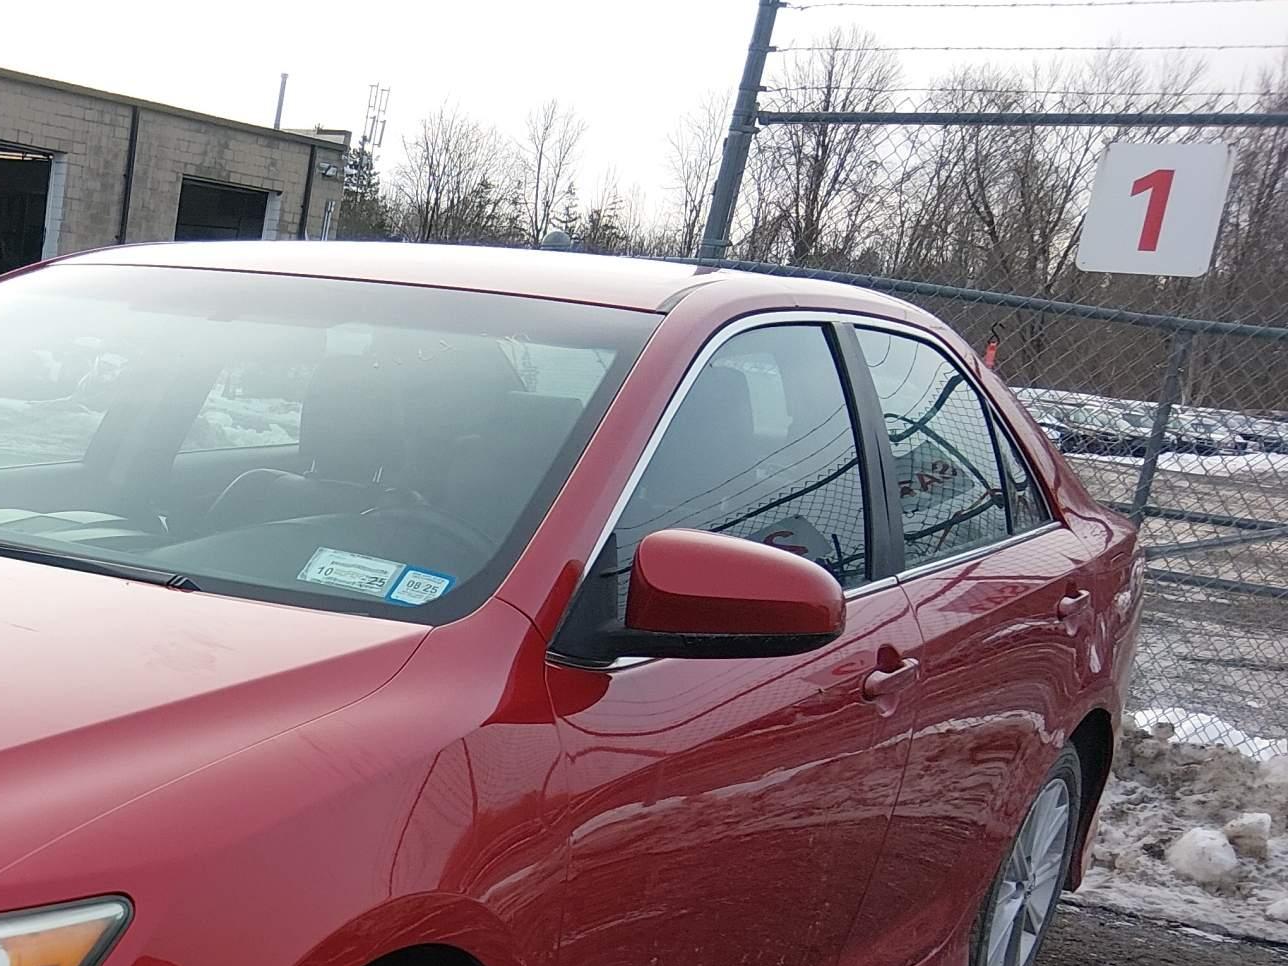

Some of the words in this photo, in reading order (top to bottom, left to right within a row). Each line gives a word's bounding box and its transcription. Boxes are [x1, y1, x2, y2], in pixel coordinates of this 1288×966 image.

[1129, 168, 1176, 252] 1
[317, 566, 334, 577] 10
[366, 576, 386, 588] 25
[406, 579, 421, 590] 08
[423, 583, 439, 594] 25
